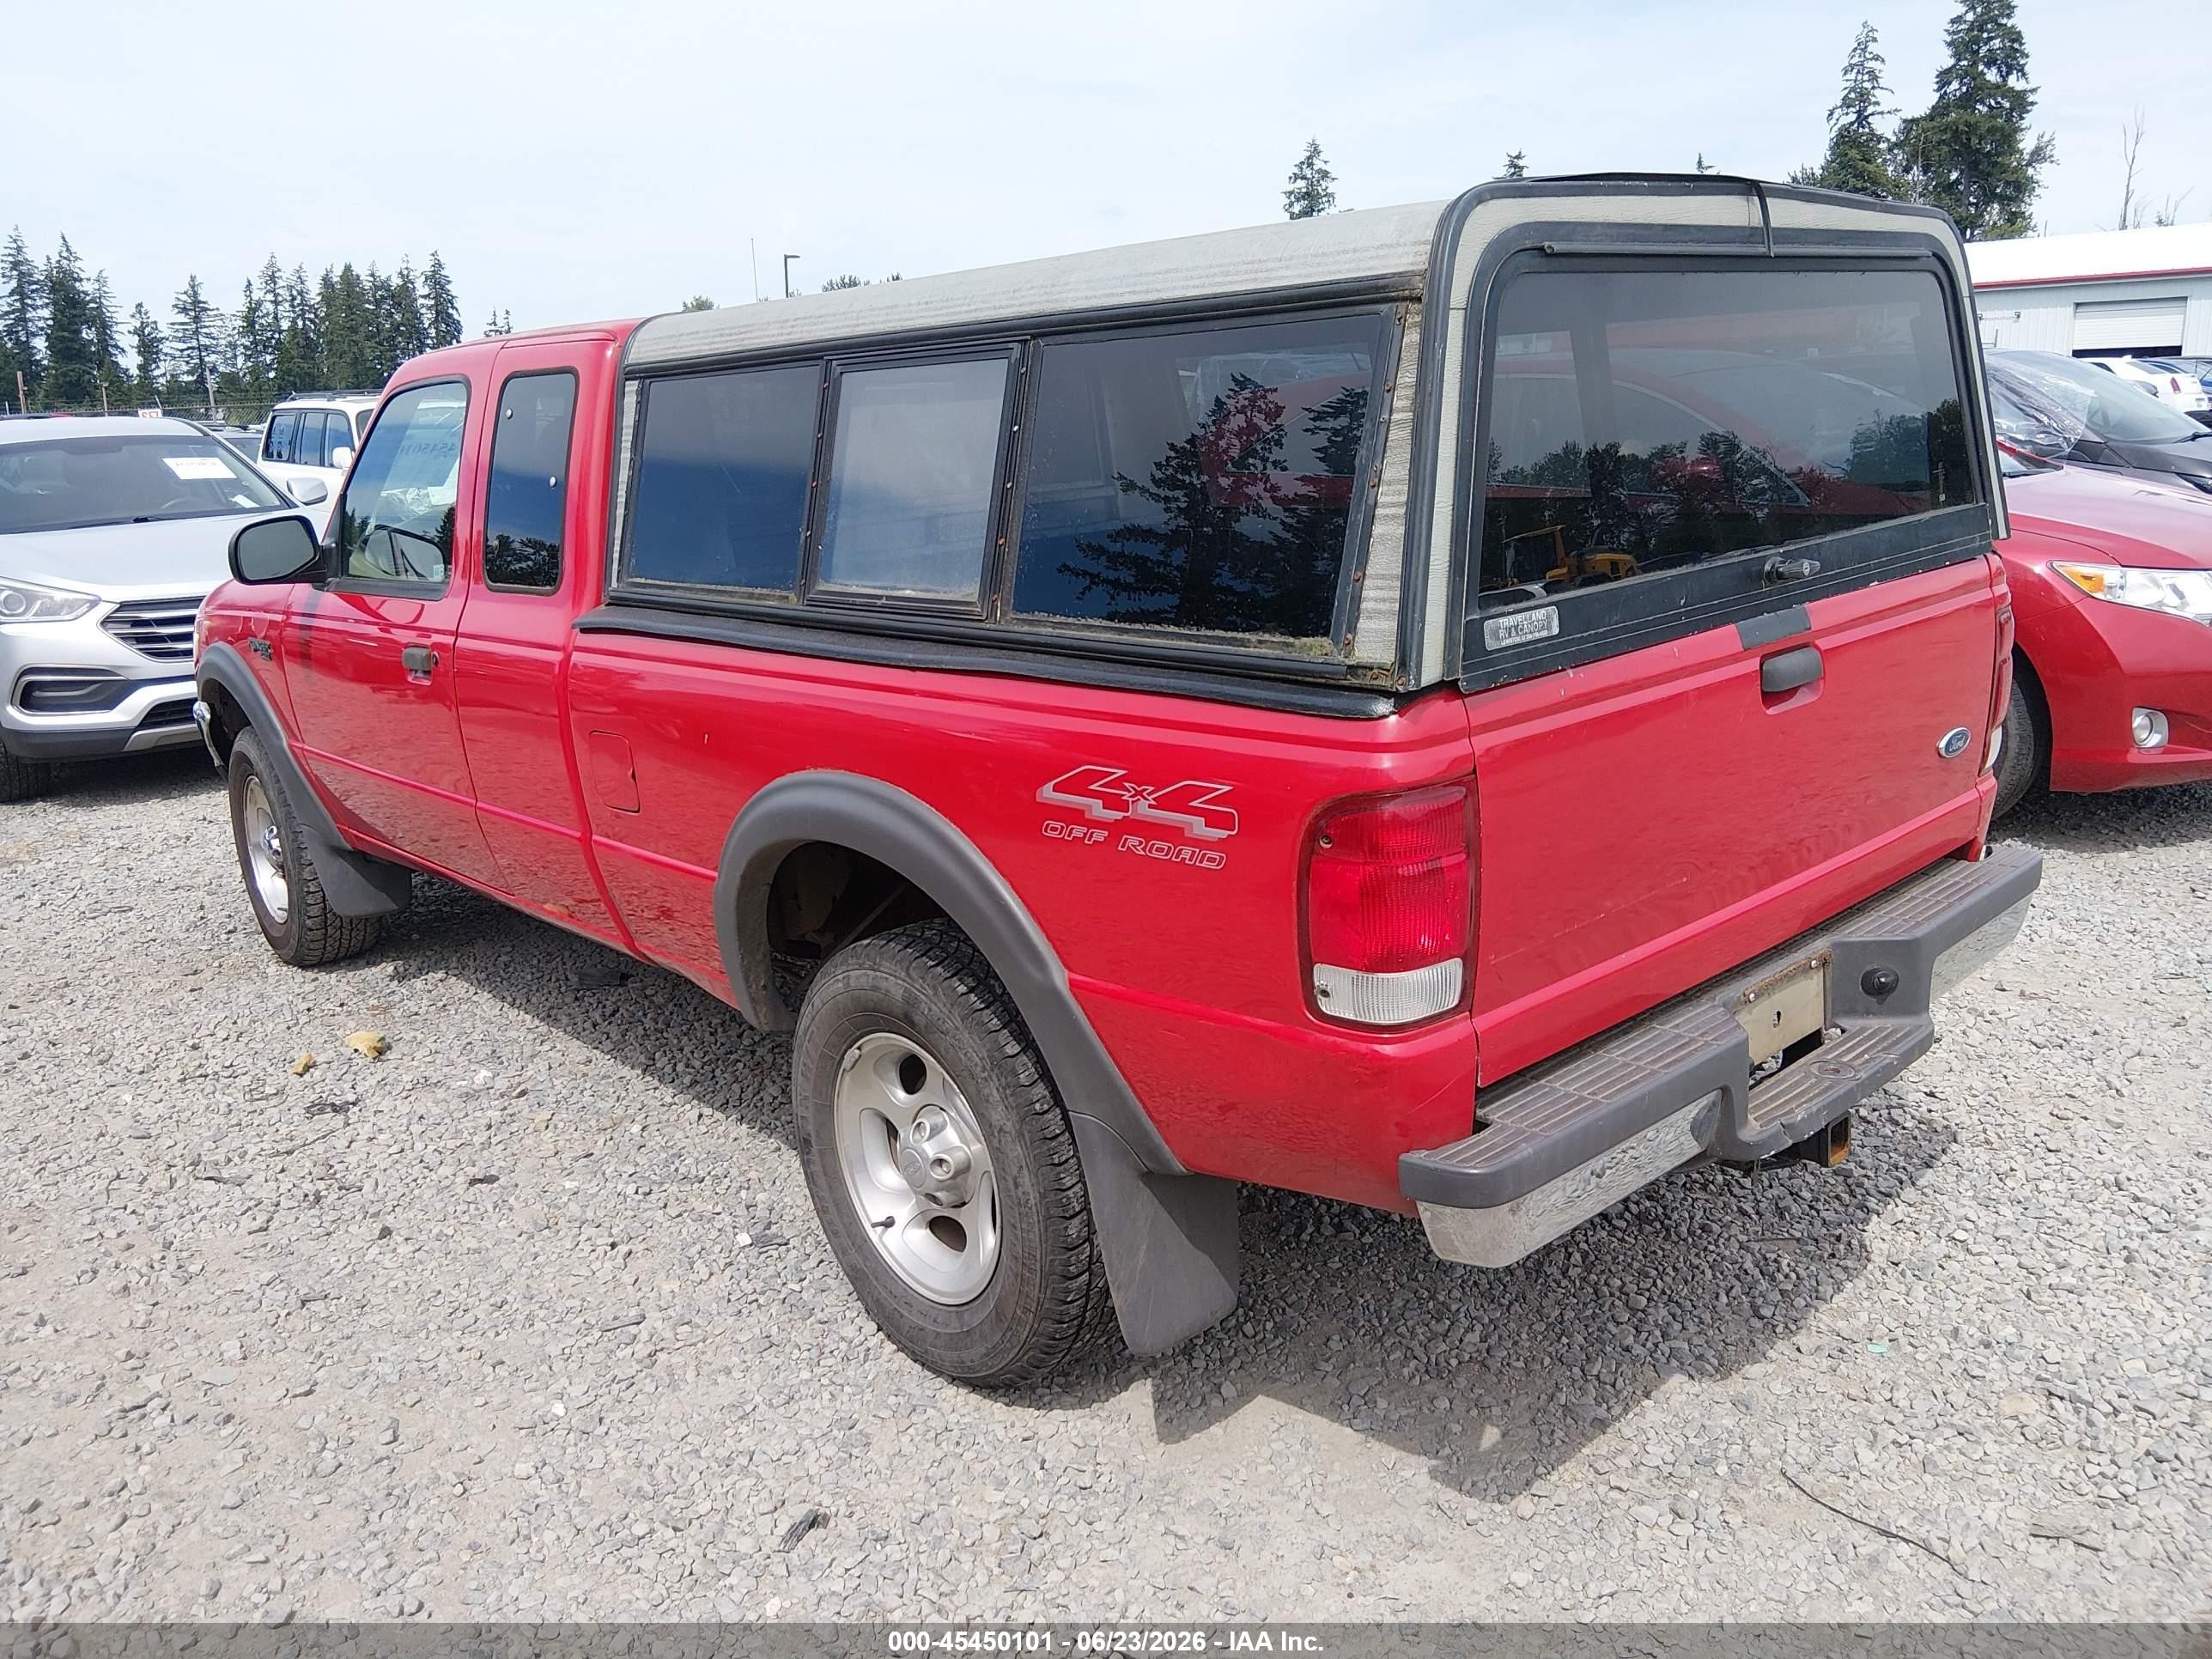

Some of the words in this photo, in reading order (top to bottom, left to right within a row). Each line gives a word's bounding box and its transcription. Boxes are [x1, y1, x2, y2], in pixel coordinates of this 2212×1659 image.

[1498, 611, 1547, 629] TRAVELLAND
[1499, 626, 1510, 640] RV
[1511, 628, 1516, 637] &
[1518, 619, 1547, 635] CANOPY
[1036, 764, 1238, 842] 4x4
[1042, 820, 1109, 845] OFF
[1118, 835, 1226, 870] ROAD
